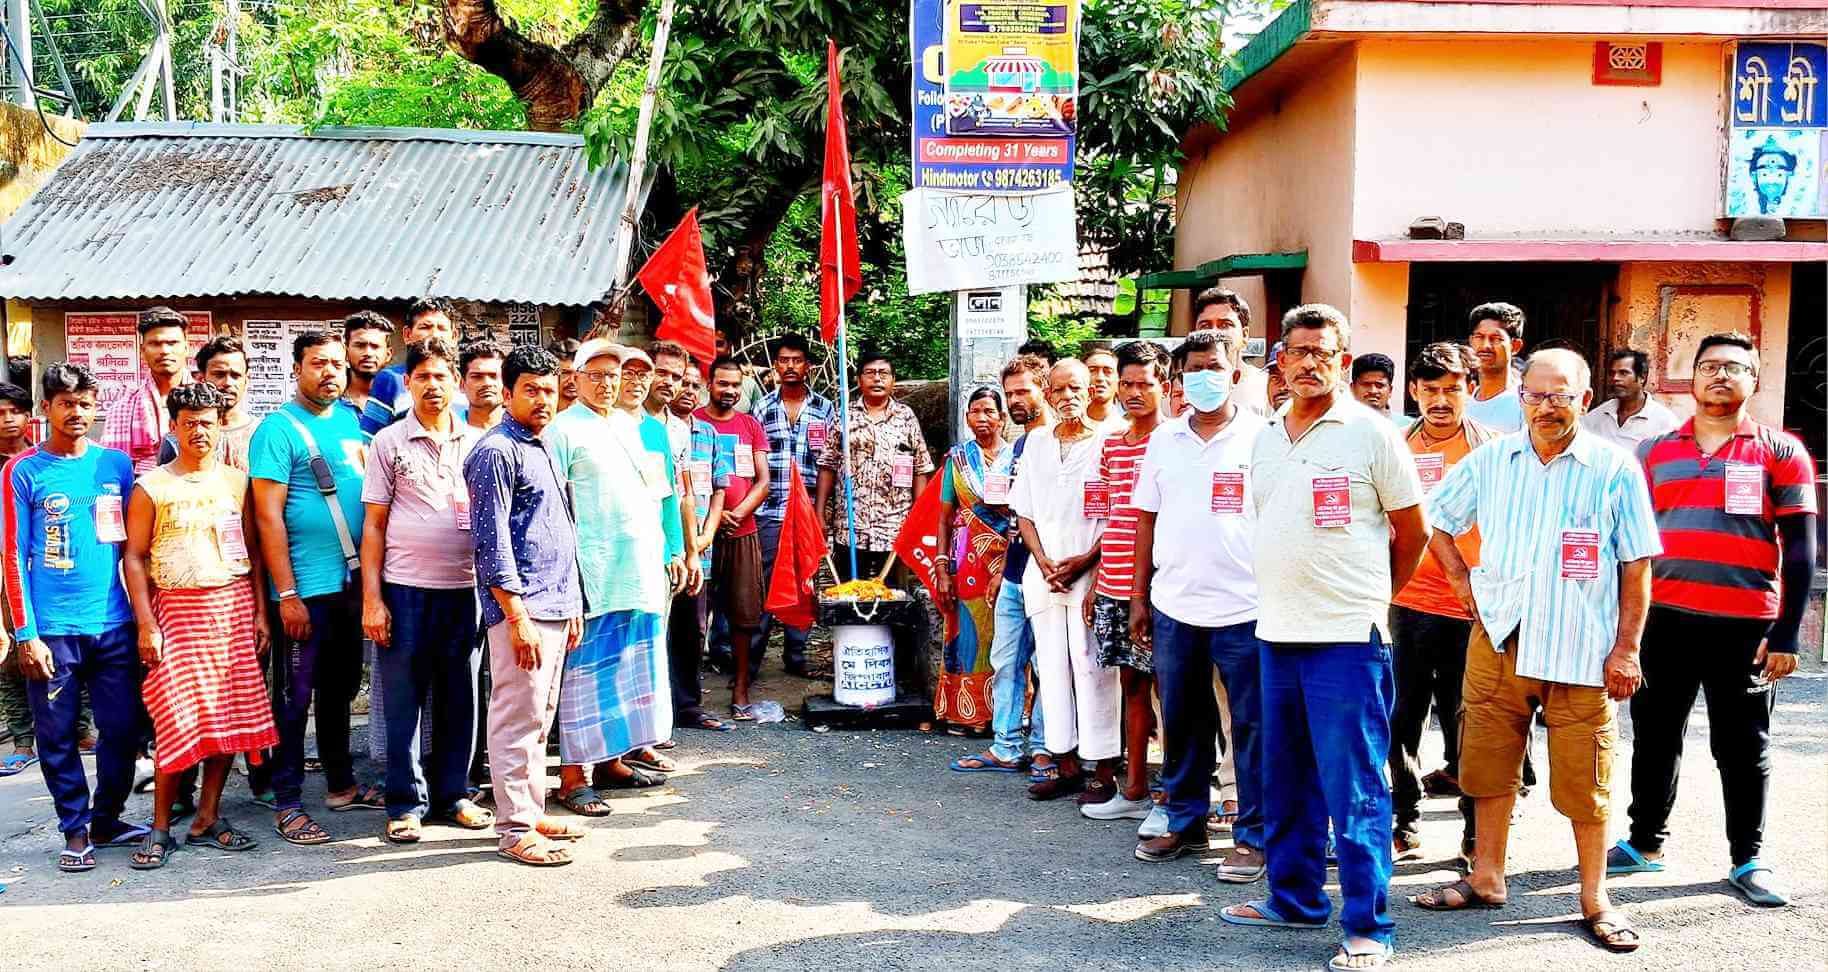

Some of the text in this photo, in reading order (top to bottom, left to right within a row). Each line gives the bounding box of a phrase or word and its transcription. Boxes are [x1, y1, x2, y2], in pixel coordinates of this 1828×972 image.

[1736, 55, 1818, 123] শ্রী শ্রী
[926, 141, 1058, 161] Completing 31 Years
[921, 168, 1062, 187] Hindmotor 9874263185
